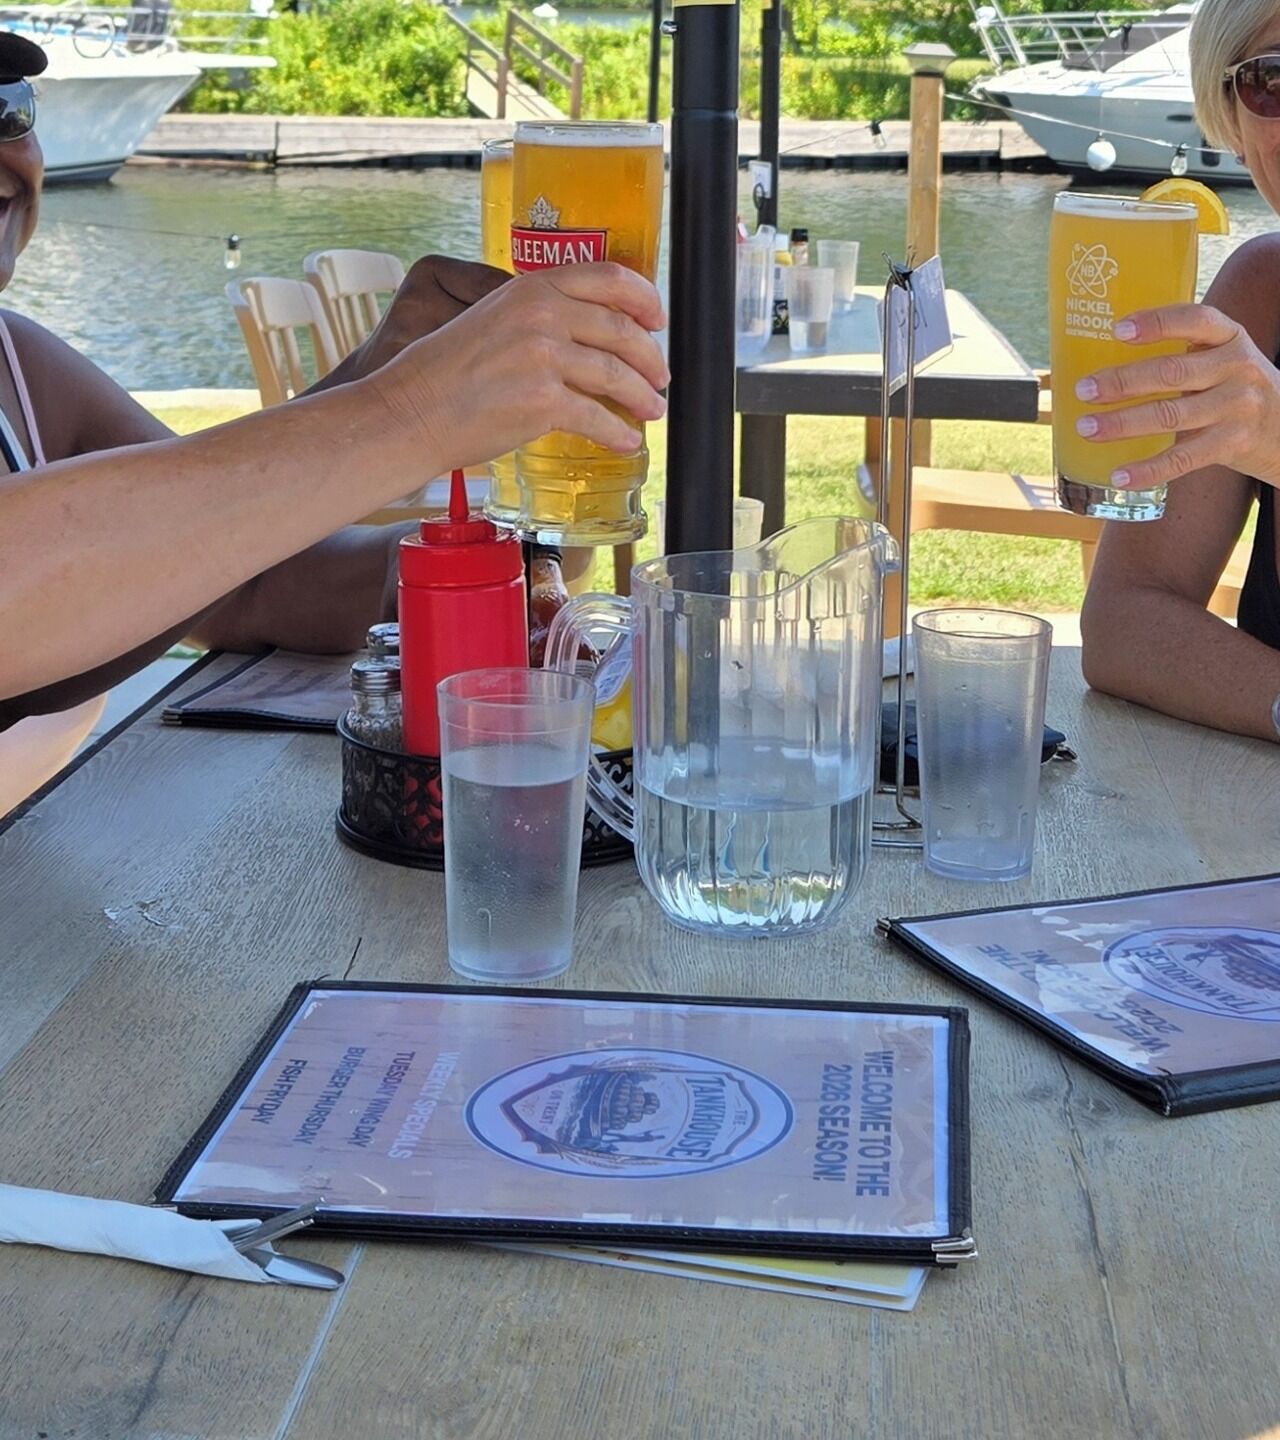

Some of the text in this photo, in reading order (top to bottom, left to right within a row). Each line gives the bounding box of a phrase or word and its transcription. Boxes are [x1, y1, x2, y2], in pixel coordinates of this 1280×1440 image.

[513, 237, 594, 265] SLEEMAN
[1066, 298, 1114, 316] NICKEL
[1066, 312, 1113, 330] BROOK
[976, 943, 1028, 970] THE
[277, 1059, 308, 1083] FISH
[293, 1047, 368, 1145] BURGER THURSDAY
[347, 1051, 416, 1148] TUESDAY WING DAY
[388, 1051, 461, 1159] WEEKLY SPECIALS
[666, 1075, 726, 1159] TANKHOUSE
[813, 1063, 853, 1182] 2026 SEASON!
[856, 1050, 894, 1196] WELCOME TO THE
